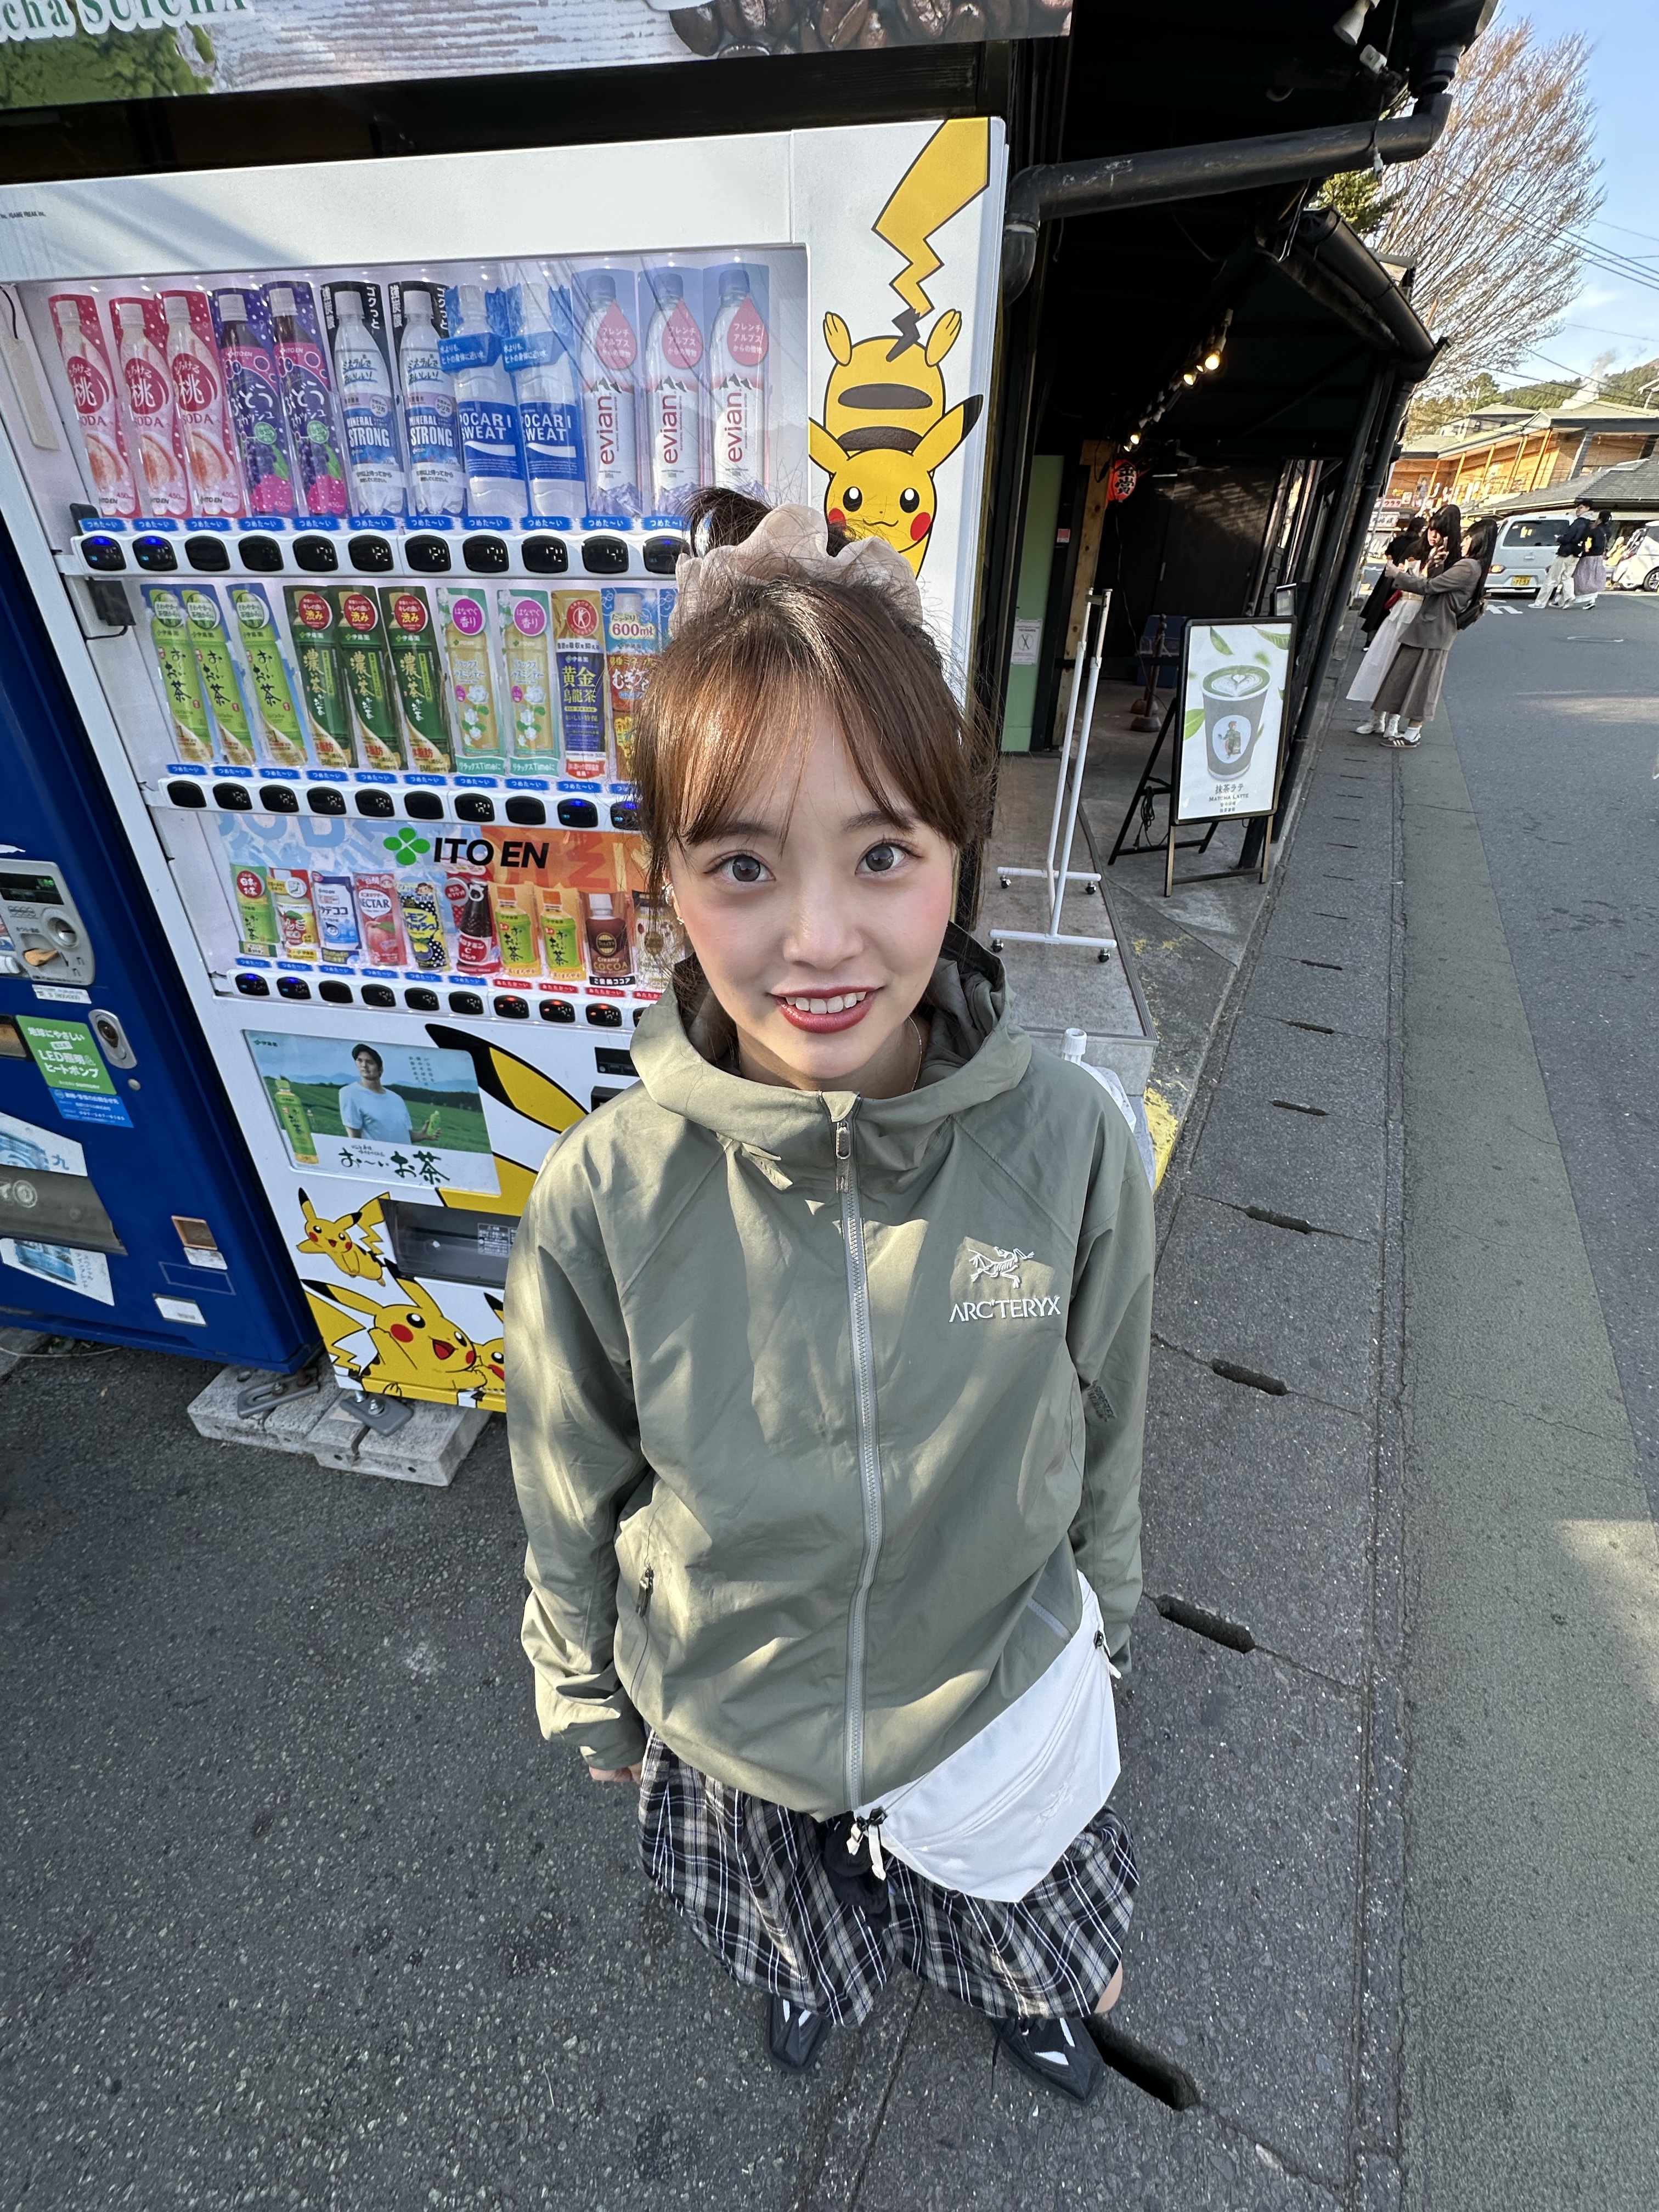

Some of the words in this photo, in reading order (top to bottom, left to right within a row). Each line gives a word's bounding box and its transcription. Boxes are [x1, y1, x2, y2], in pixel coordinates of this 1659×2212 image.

[602, 338, 630, 347] アルプス
[669, 336, 696, 346] アルプス
[734, 334, 763, 342] アルプス
[74, 376, 97, 407] 桃
[131, 378, 156, 407] 桃
[179, 374, 205, 404] 桃
[285, 381, 325, 415] ぶどう
[231, 383, 273, 416] ぶどう
[347, 417, 373, 427] MINERAL
[409, 416, 437, 425] MINERAL
[597, 395, 614, 464] evian
[663, 394, 679, 464] evian
[725, 392, 743, 462] evian
[348, 427, 390, 447] STRONG
[410, 426, 453, 447] STRONG
[306, 610, 323, 620] 渋み
[351, 611, 369, 622] 渋み
[401, 612, 419, 622] 渋み
[460, 617, 476, 628] 香り
[522, 618, 538, 628] 香り
[303, 648, 327, 693] 濃い茶
[350, 651, 375, 696] 濃い茶
[400, 652, 425, 698] 濃い茶
[562, 665, 597, 688] 黄金
[563, 689, 597, 703] 烏龍茶
[1215, 783, 1244, 794] 抹茶ラテ
[434, 837, 493, 865] ITO
[501, 841, 549, 868] EN
[319, 906, 348, 915] タデココ
[407, 912, 427, 922] モン
[594, 961, 629, 970] COCOA
[44, 1063, 99, 1079] ヒートポンプ
[338, 1147, 450, 1185] お～いお茶
[949, 1296, 1061, 1323] ARC'TERYX
